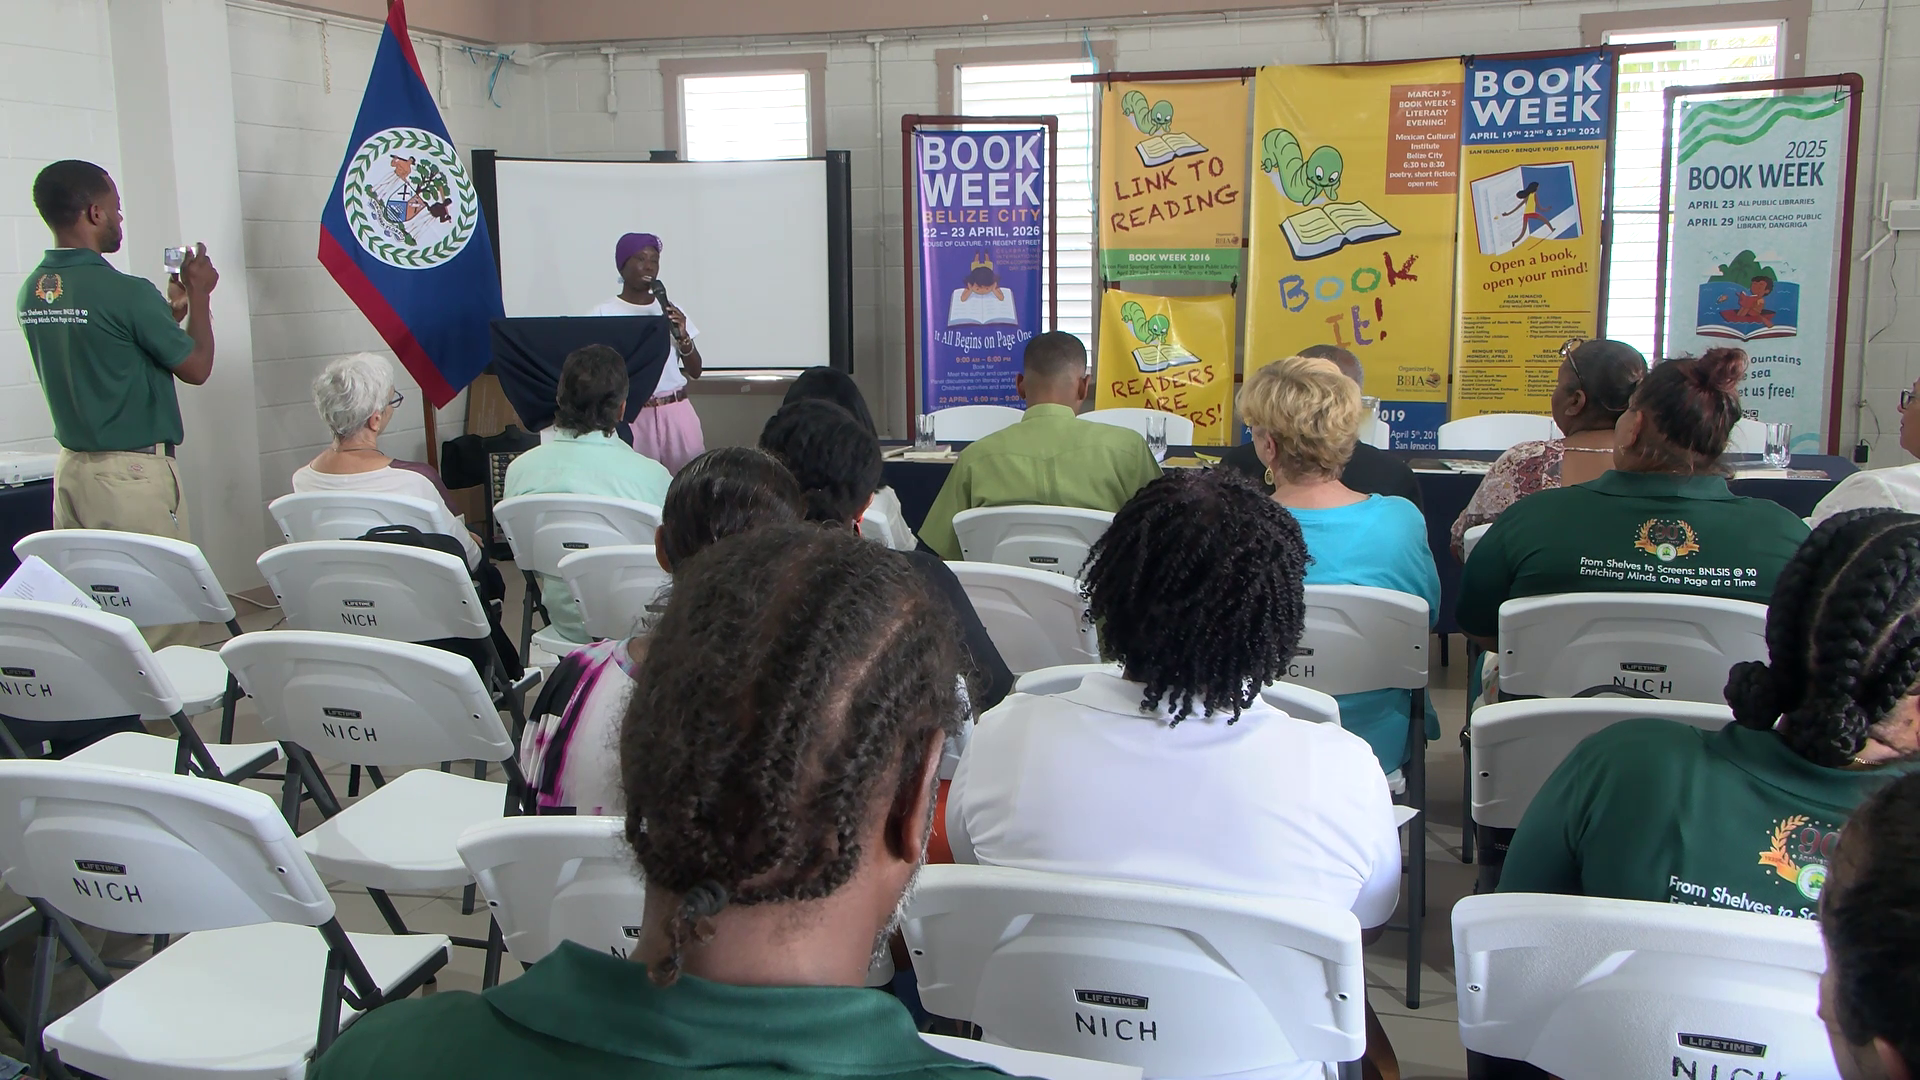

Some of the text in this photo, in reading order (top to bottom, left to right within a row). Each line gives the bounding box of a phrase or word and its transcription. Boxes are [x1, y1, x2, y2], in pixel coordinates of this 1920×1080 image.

[1474, 64, 1602, 98] BOOK
[1408, 90, 1439, 98] MARCH
[1399, 99, 1456, 108] BOOK WEEK'S
[1471, 94, 1601, 127] WEEK
[1405, 109, 1448, 117] LITERARY
[1406, 119, 1446, 127] EVENING!
[1426, 132, 1456, 140] Cultural
[1469, 131, 1499, 140] APRIL
[1579, 127, 1600, 135] 2024
[923, 135, 1040, 170] BOOK
[1428, 152, 1443, 160] City
[1785, 140, 1828, 159] 2025
[1115, 156, 1224, 200] LINK TO
[1688, 162, 1825, 191] BOOK WEEK
[922, 172, 1040, 207] WEEK
[1111, 184, 1239, 233] READING
[1687, 200, 1718, 209] APRIL
[1721, 200, 1735, 209] 23
[1779, 198, 1815, 206] LIBRARIES
[925, 209, 1040, 224] BELIZE CITY
[1687, 218, 1718, 227] APRIL
[1721, 217, 1734, 226] 29
[923, 226, 1040, 238] 22 23 APRIL, 2026
[1128, 253, 1210, 262] BOOK WEEK 2016
[1489, 247, 1577, 274] Open a book,
[1278, 251, 1420, 312] BOOK
[1482, 261, 1589, 292] open your mind!
[941, 330, 953, 346] All
[955, 331, 982, 354] Begins
[984, 336, 995, 349] on
[996, 330, 1016, 351] Page
[1016, 328, 1032, 342] One
[1750, 355, 1802, 366] ountains
[1111, 365, 1214, 398] READERS
[1397, 375, 1424, 386] BBIA
[1751, 368, 1771, 379] sea
[1738, 383, 1795, 400] et us free!
[1144, 392, 1188, 412] ARE
[1390, 430, 1409, 440] April
[1423, 430, 1438, 440] 201
[1395, 440, 1436, 450] San Ignacio
[1580, 556, 1757, 577] From Shelves to Screens: BNLSIS @ 90
[1580, 566, 1624, 580] Enriching
[1627, 571, 1656, 582] Minds
[1660, 575, 1680, 584] One
[1683, 577, 1708, 587] Page
[1733, 578, 1756, 586] Time
[92, 594, 131, 607] NICH
[341, 613, 377, 626] NICH
[1288, 664, 1314, 677] CH
[1626, 664, 1661, 672] LIFETIME
[0, 681, 52, 697] NICH
[1613, 676, 1672, 693] NICH
[322, 723, 378, 742] NICH
[81, 862, 120, 872] LIFETIME
[73, 877, 142, 903] NICH
[1669, 875, 1707, 898] From
[1711, 886, 1772, 915] Shelves
[1778, 906, 1793, 918] to
[1084, 993, 1139, 1006] LIFETIME
[1075, 1012, 1157, 1041] NICH
[1688, 1036, 1755, 1053] LIFETIME
